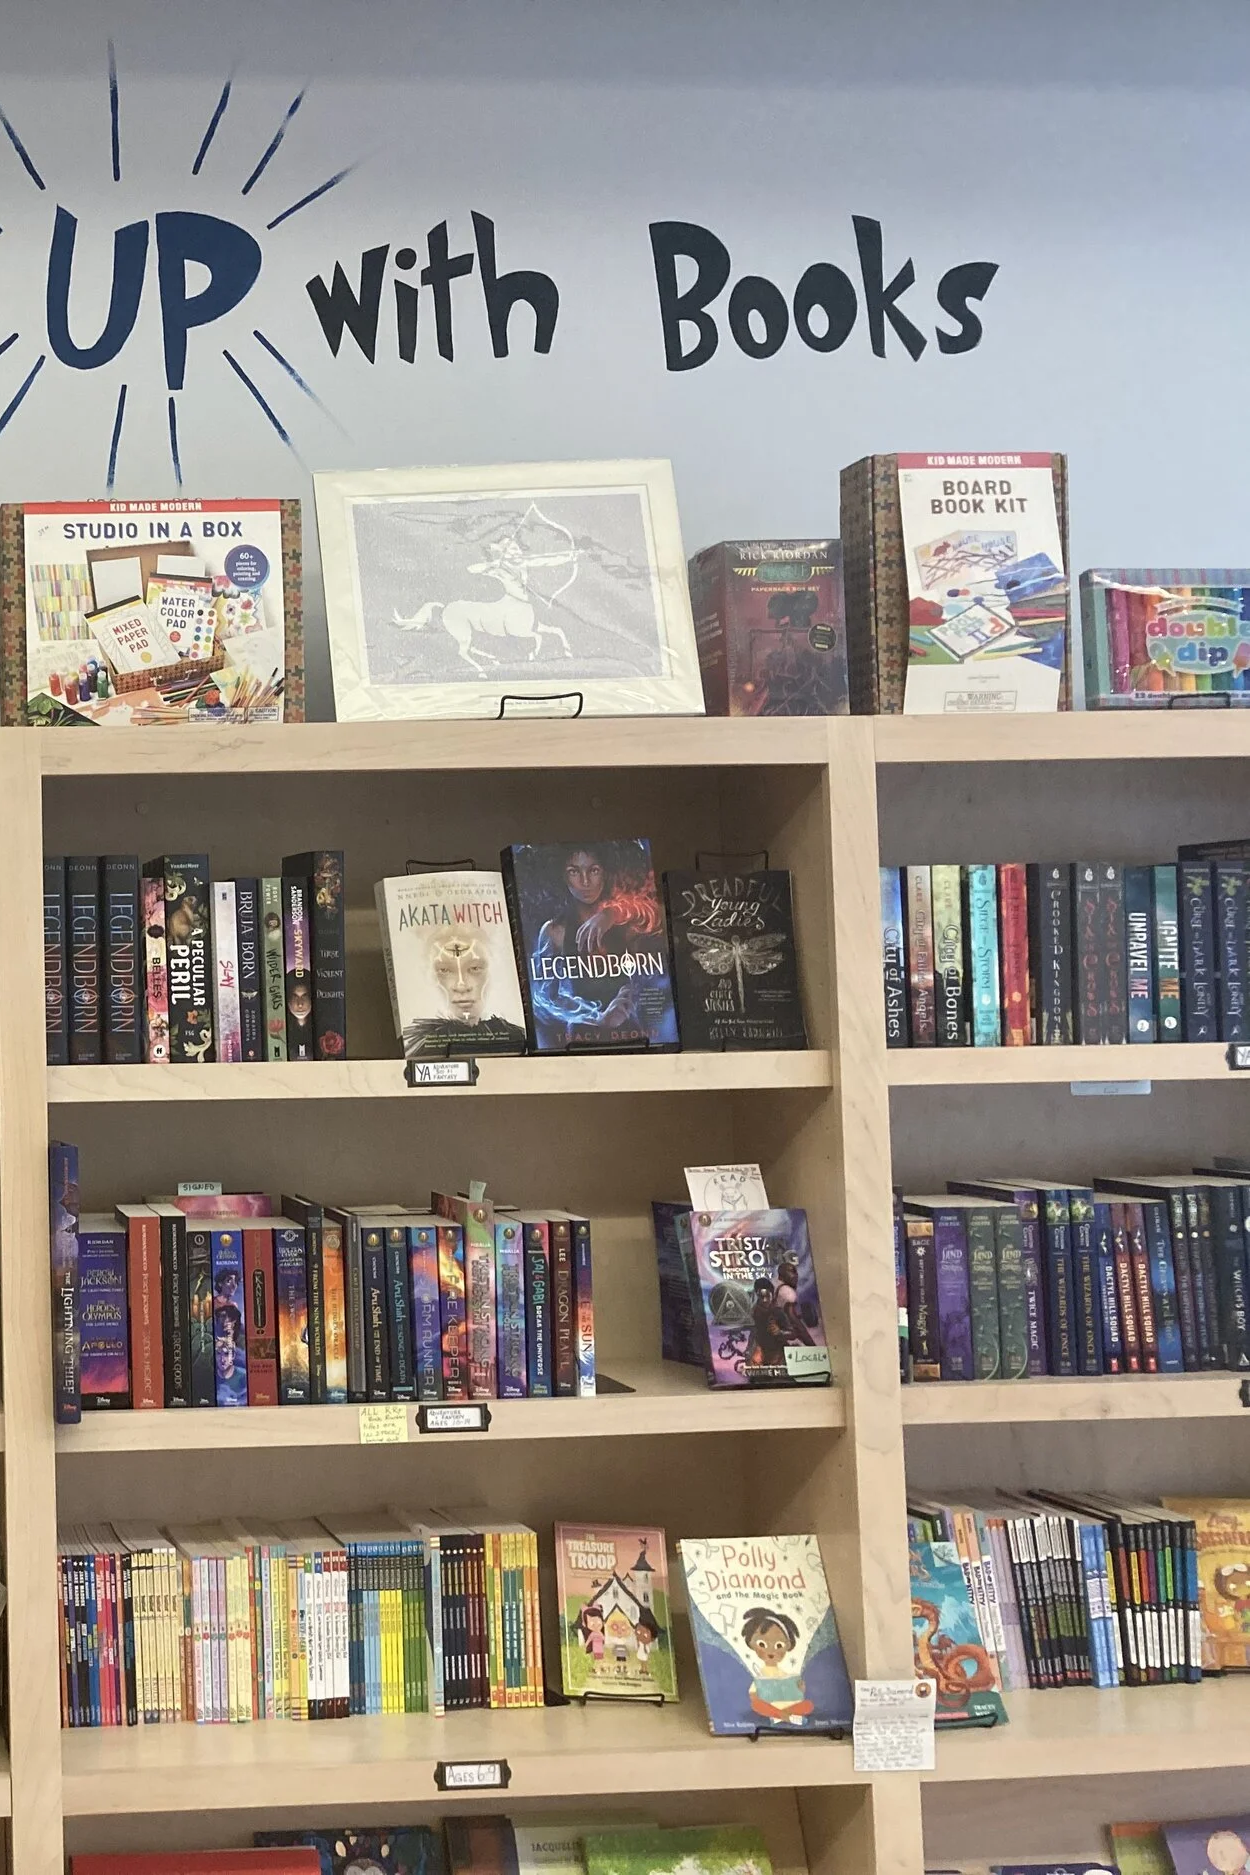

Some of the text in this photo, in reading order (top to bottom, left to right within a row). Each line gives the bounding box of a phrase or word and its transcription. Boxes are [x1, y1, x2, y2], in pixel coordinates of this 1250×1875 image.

[47, 204, 262, 390] UP
[649, 215, 1000, 371] Books
[927, 455, 1021, 465] KID MADE MODERN
[943, 480, 1012, 495] BOARD
[110, 502, 201, 512] KID MADE MODERN
[931, 498, 1028, 514] BOOK KIT
[63, 521, 243, 539] STUDIO IN A BOX
[740, 551, 828, 560] RICK RIORDAN
[161, 597, 196, 608] WATER
[160, 607, 195, 619] COLOR
[112, 619, 142, 636] MIXED
[166, 618, 187, 629] PAD
[117, 627, 149, 645] PAPER
[130, 640, 149, 653] PAD
[1178, 642, 1228, 666] dip
[399, 902, 503, 932] AKATA WITCH
[1156, 920, 1179, 971] IGNITE
[110, 893, 135, 1034] LEGENDBORN
[1128, 912, 1149, 1000] UNRAVEL ME
[191, 928, 205, 1007] A PECULIAR
[531, 948, 664, 982] LEGENDBORN
[151, 957, 162, 999] BELLES
[170, 944, 191, 1005] PERIL
[416, 1065, 431, 1081] YA
[182, 1183, 215, 1192] SIGNED
[62, 1287, 75, 1356] LIGHTNING
[795, 1351, 824, 1362] LOCAL
[63, 1357, 75, 1394] THIEF
[566, 1541, 615, 1555] TREASURE
[569, 1554, 616, 1571] TROOP
[722, 1545, 778, 1569] Polly
[704, 1568, 807, 1591] Diamond
[716, 1590, 804, 1601] and the Magic Book
